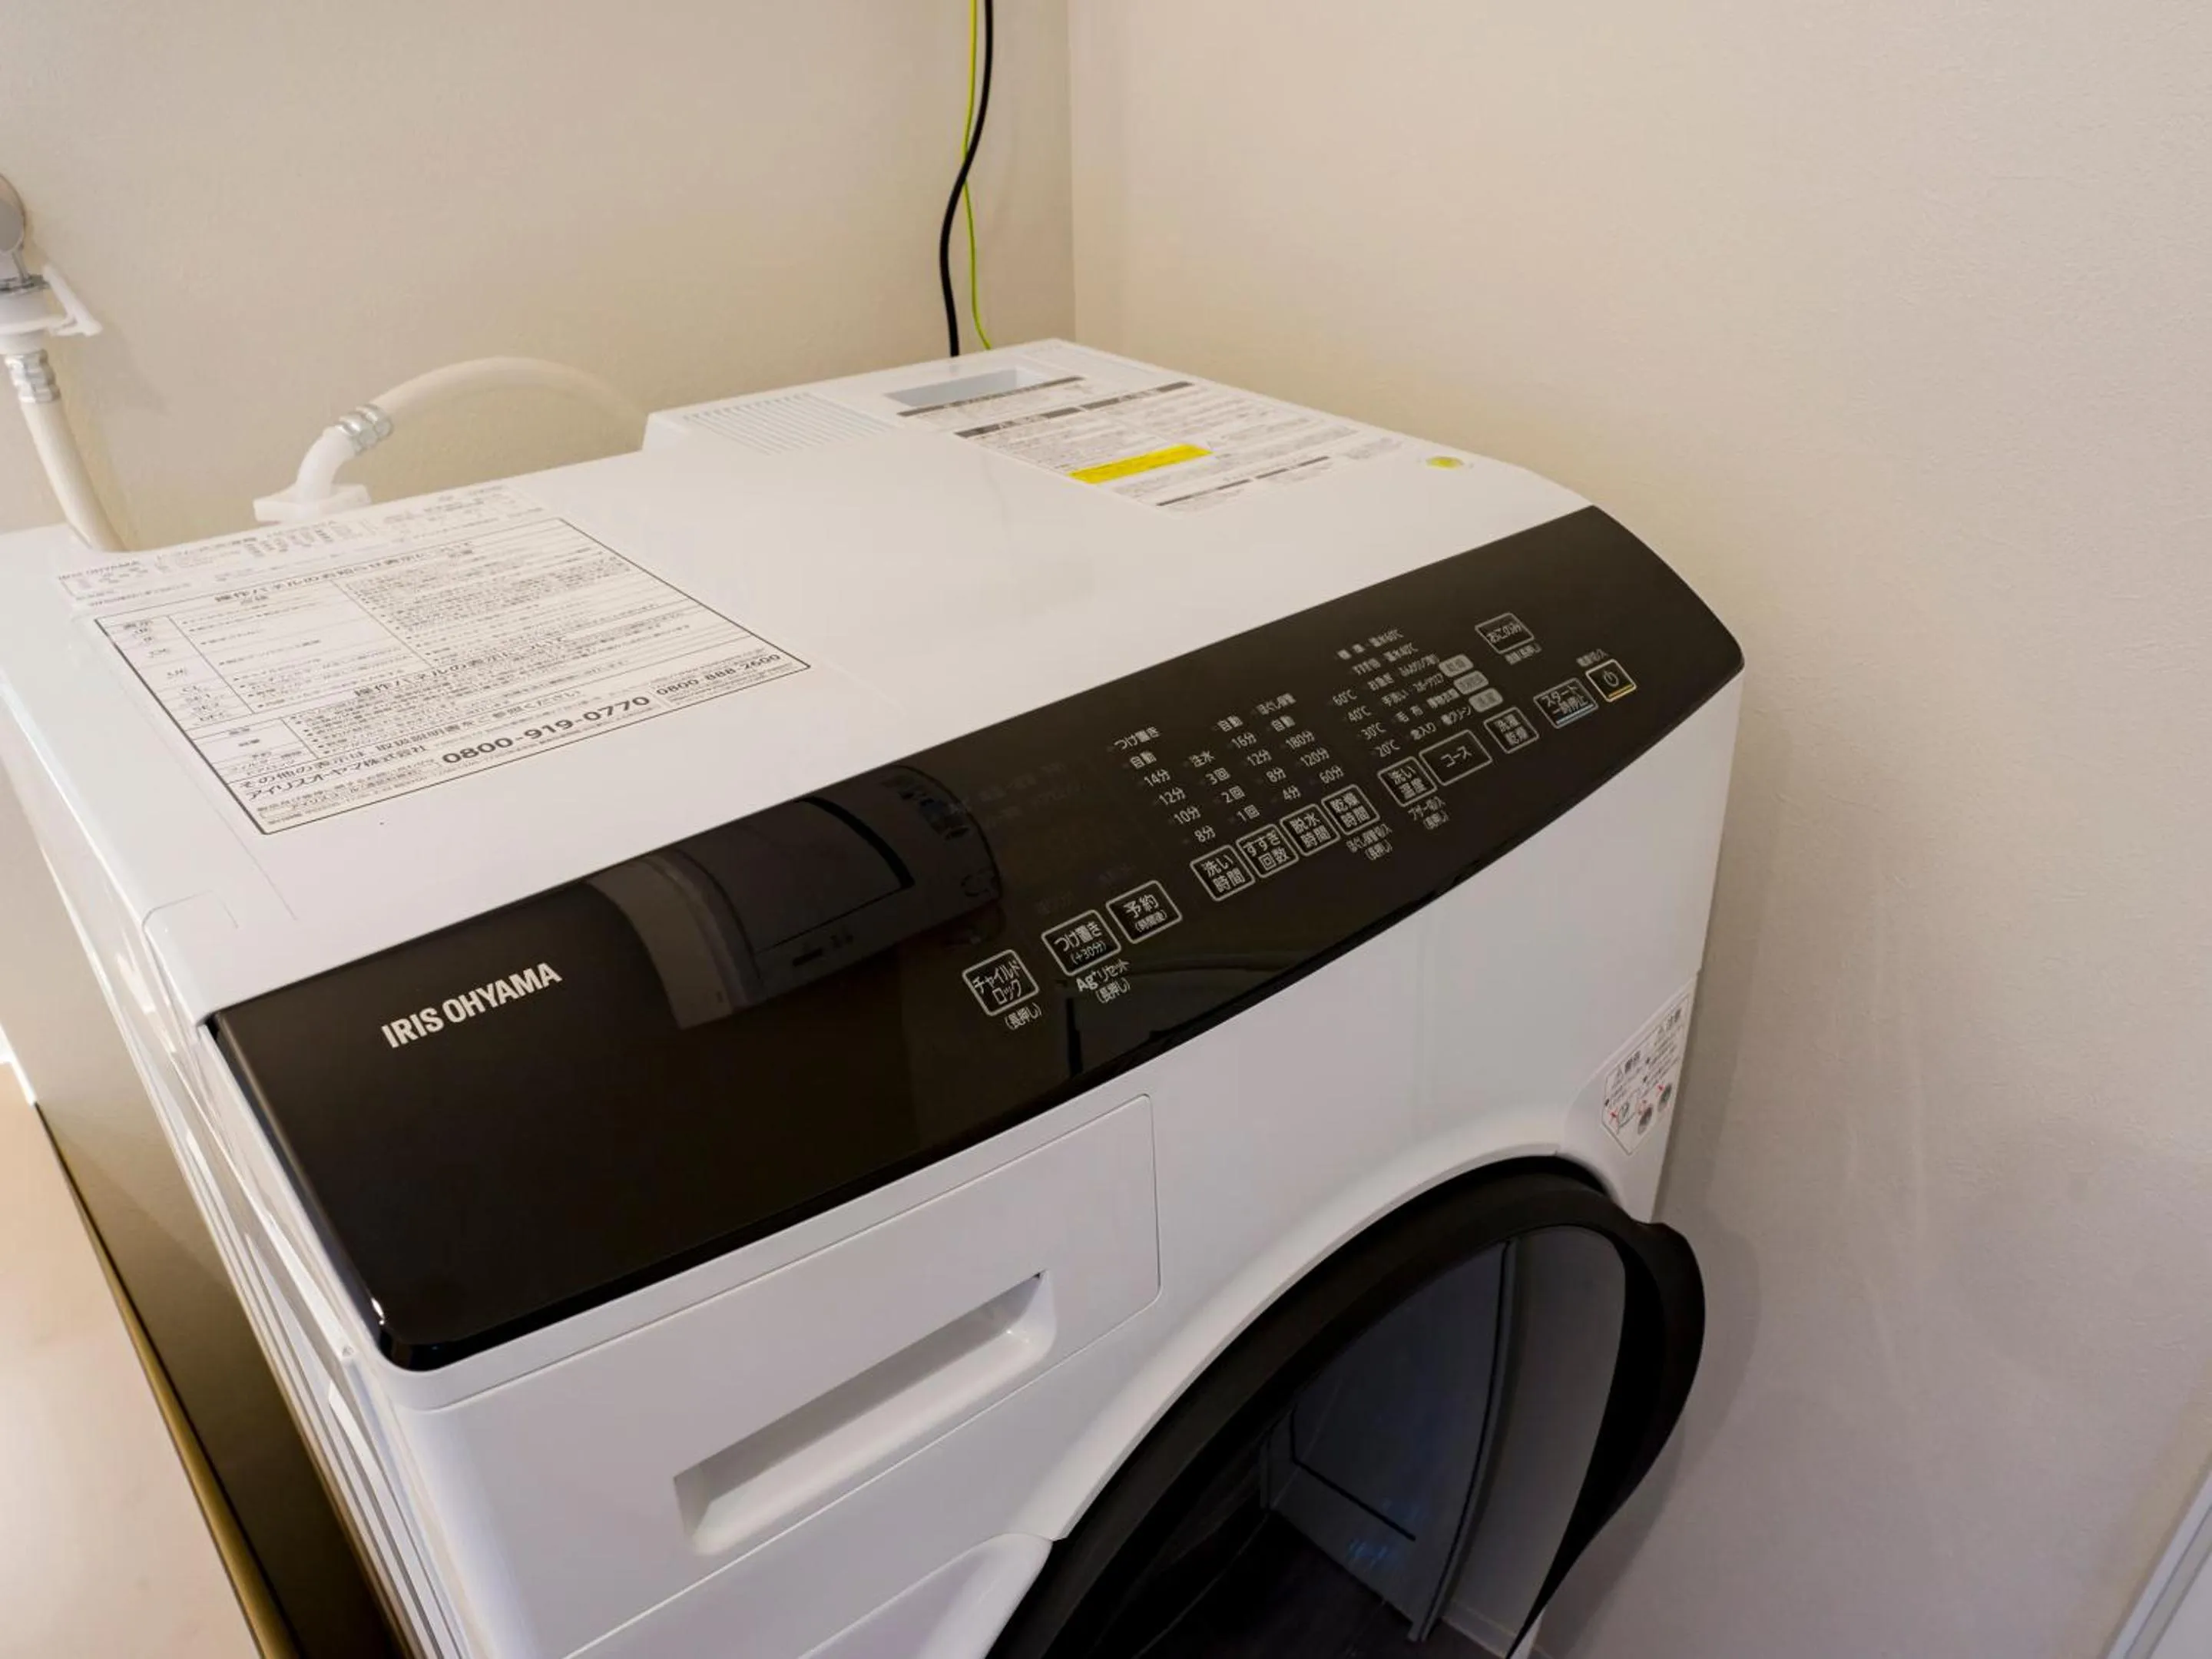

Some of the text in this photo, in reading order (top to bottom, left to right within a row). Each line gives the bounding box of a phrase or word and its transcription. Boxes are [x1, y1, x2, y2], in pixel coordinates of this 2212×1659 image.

[442, 695, 651, 764] 0800-919-0770
[1231, 731, 1257, 749] 16分
[1286, 730, 1316, 750] 180分
[1247, 749, 1273, 767] 12分
[1300, 747, 1330, 768] 120分
[1440, 746, 1472, 767] コース
[1144, 769, 1171, 787] 14分
[1205, 767, 1230, 786] 3回
[1266, 767, 1286, 783] 8分
[1319, 764, 1344, 784] 60分
[1388, 766, 1416, 785] 洗い
[1158, 786, 1187, 806] 12分
[1221, 785, 1246, 804] 2回
[1282, 785, 1302, 801] 4分
[1174, 806, 1201, 825] 10分
[1237, 804, 1260, 823] 1回
[1290, 813, 1322, 835] 脱水
[1339, 805, 1371, 829] 時間
[1194, 825, 1216, 843] 8分
[1243, 831, 1281, 857] すすぎ
[1300, 826, 1331, 849] 時間
[1200, 854, 1234, 878] 洗い
[1257, 847, 1291, 871] 回数
[1213, 867, 1246, 892] 時間
[1124, 894, 1159, 919] 予約
[1055, 922, 1102, 952] つけ置き
[972, 959, 1022, 994] チャイルド
[992, 980, 1022, 1005] ロック
[381, 962, 563, 1048] IRIS OHYAMA
